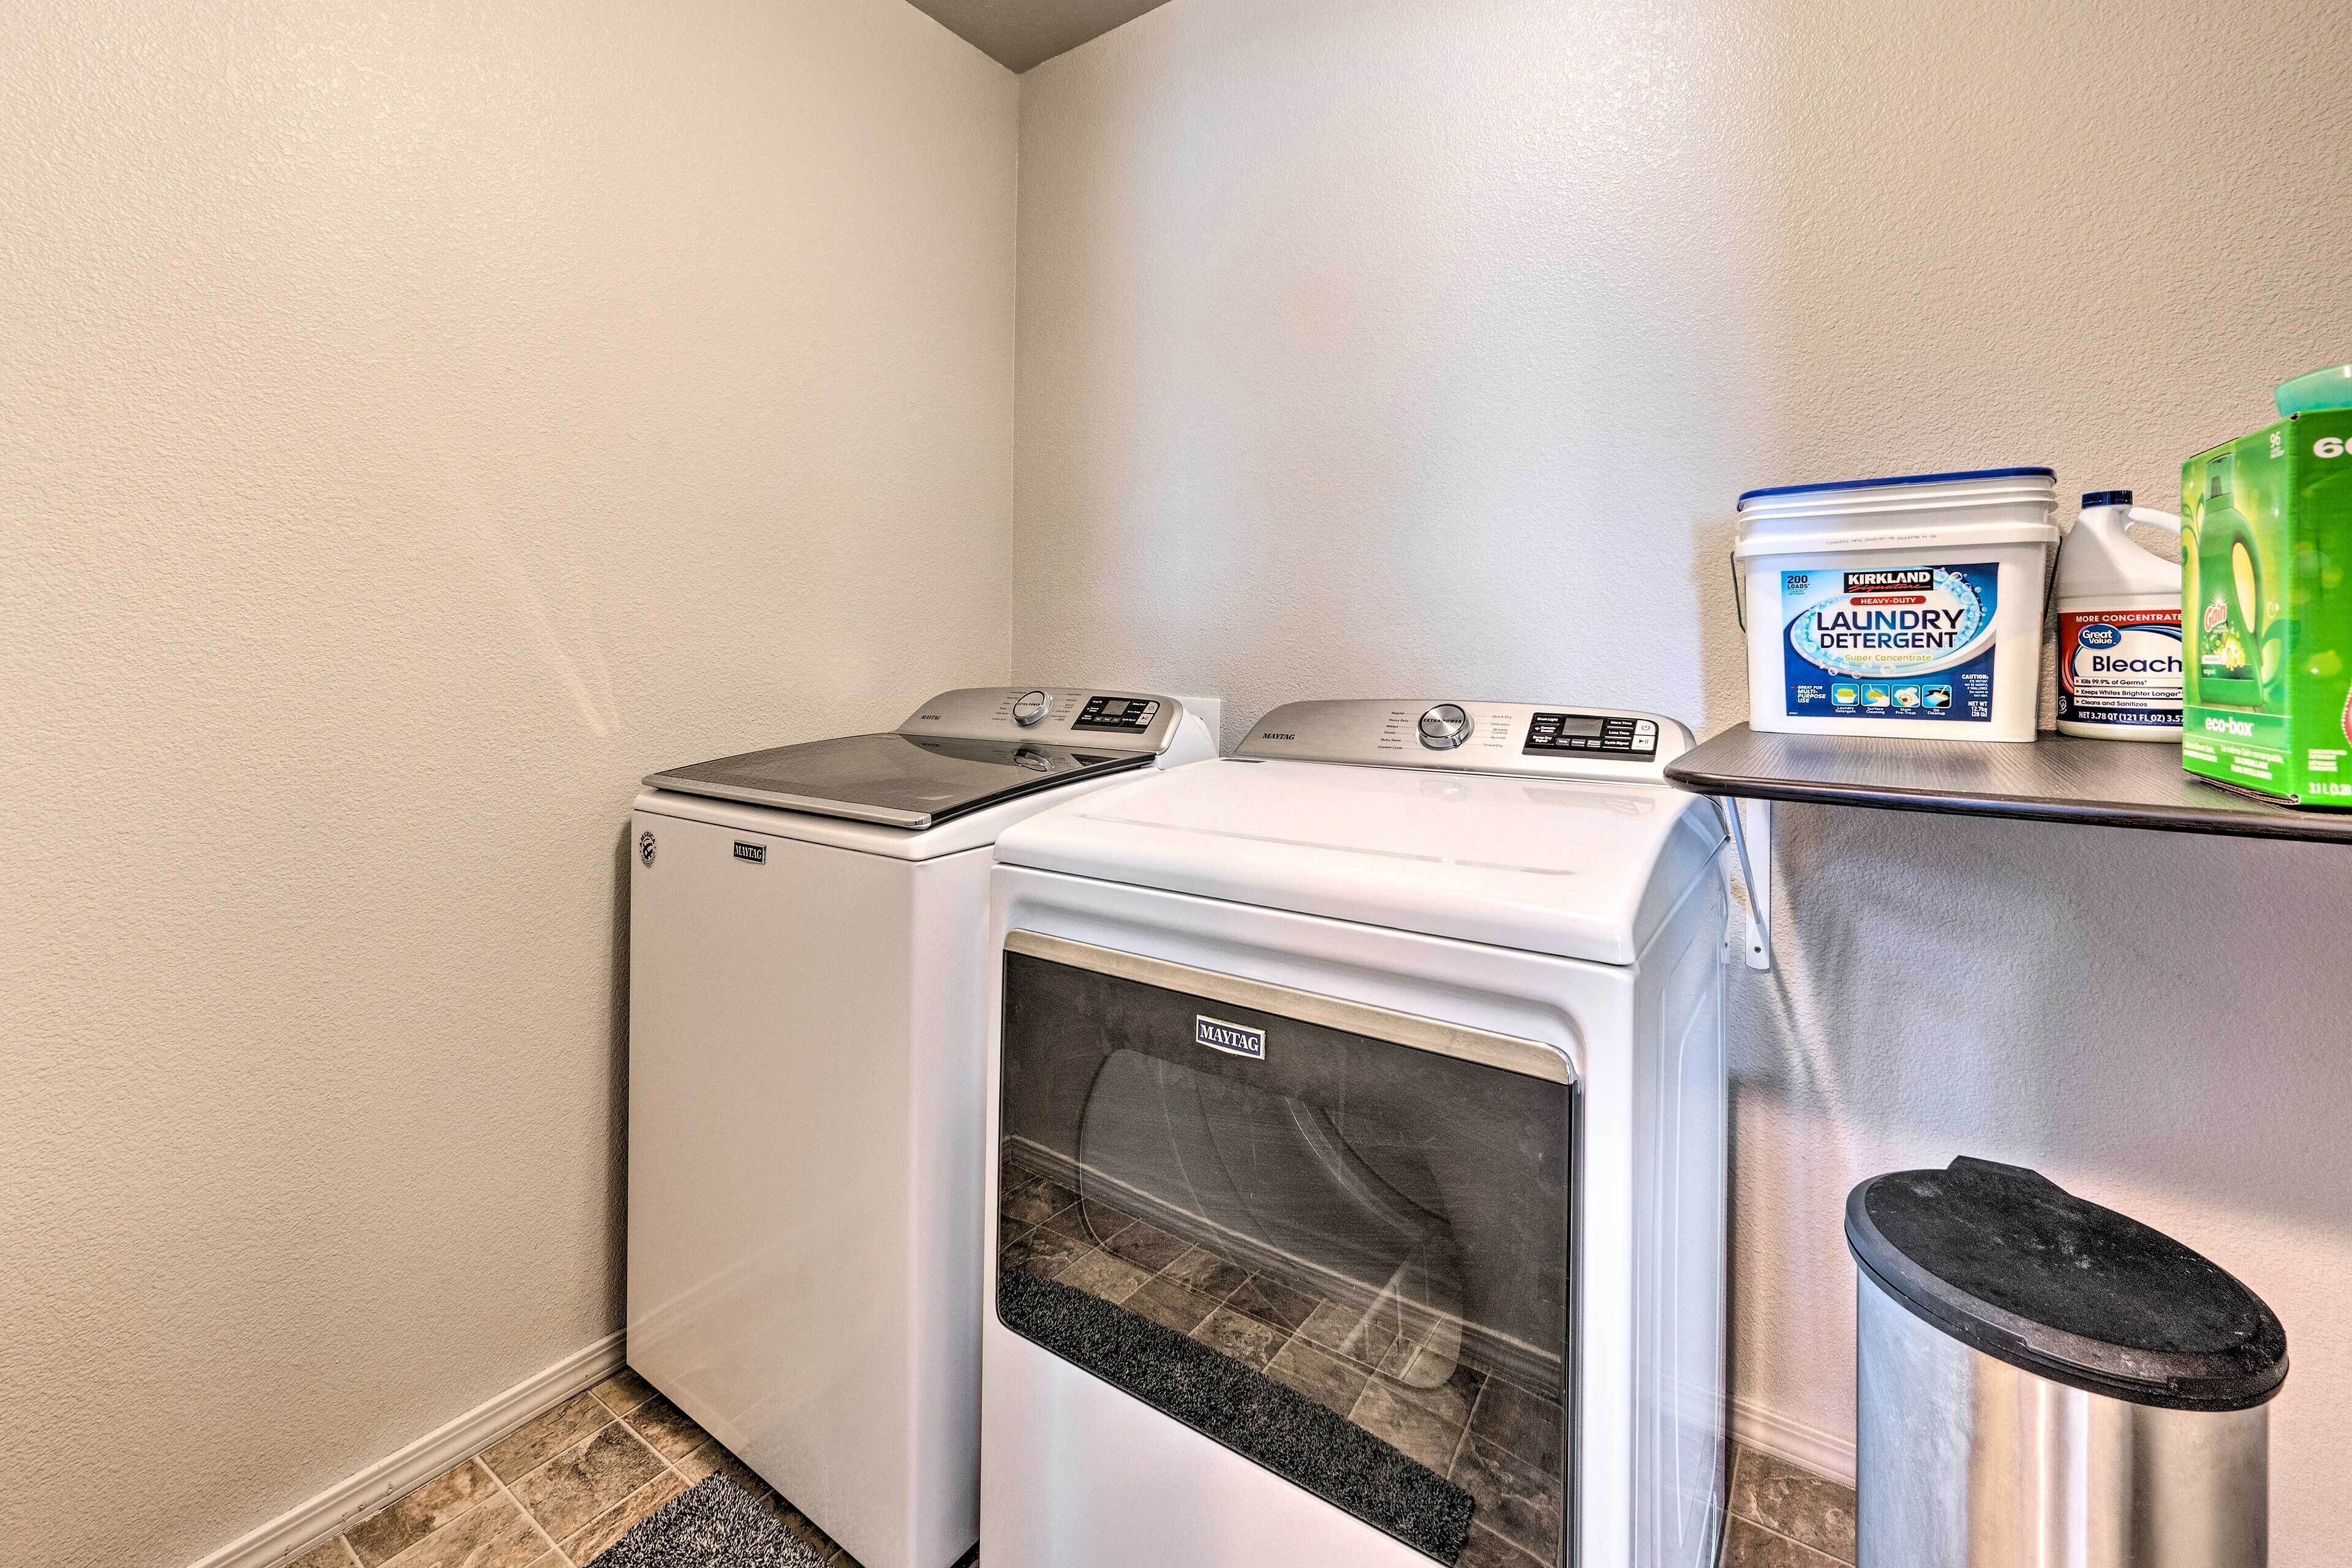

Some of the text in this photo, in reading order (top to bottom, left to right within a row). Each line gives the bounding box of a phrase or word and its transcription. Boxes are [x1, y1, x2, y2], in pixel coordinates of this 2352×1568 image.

[2270, 431, 2281, 448] 96
[2313, 437, 2352, 458] 6
[1787, 575, 1808, 583] 200
[1849, 571, 1930, 585] KIRKLAND
[1849, 583, 1930, 593] Signature
[1817, 609, 1965, 631] LAUNDRY
[2204, 603, 2226, 632] Gain
[1820, 631, 1958, 649] DETERGENT
[2082, 630, 2113, 639] Great
[2092, 655, 2182, 672] Bleach
[2150, 714, 2166, 723] OZ)
[734, 845, 762, 859] MAYTAG
[1199, 1023, 1260, 1052] MAYTAG
